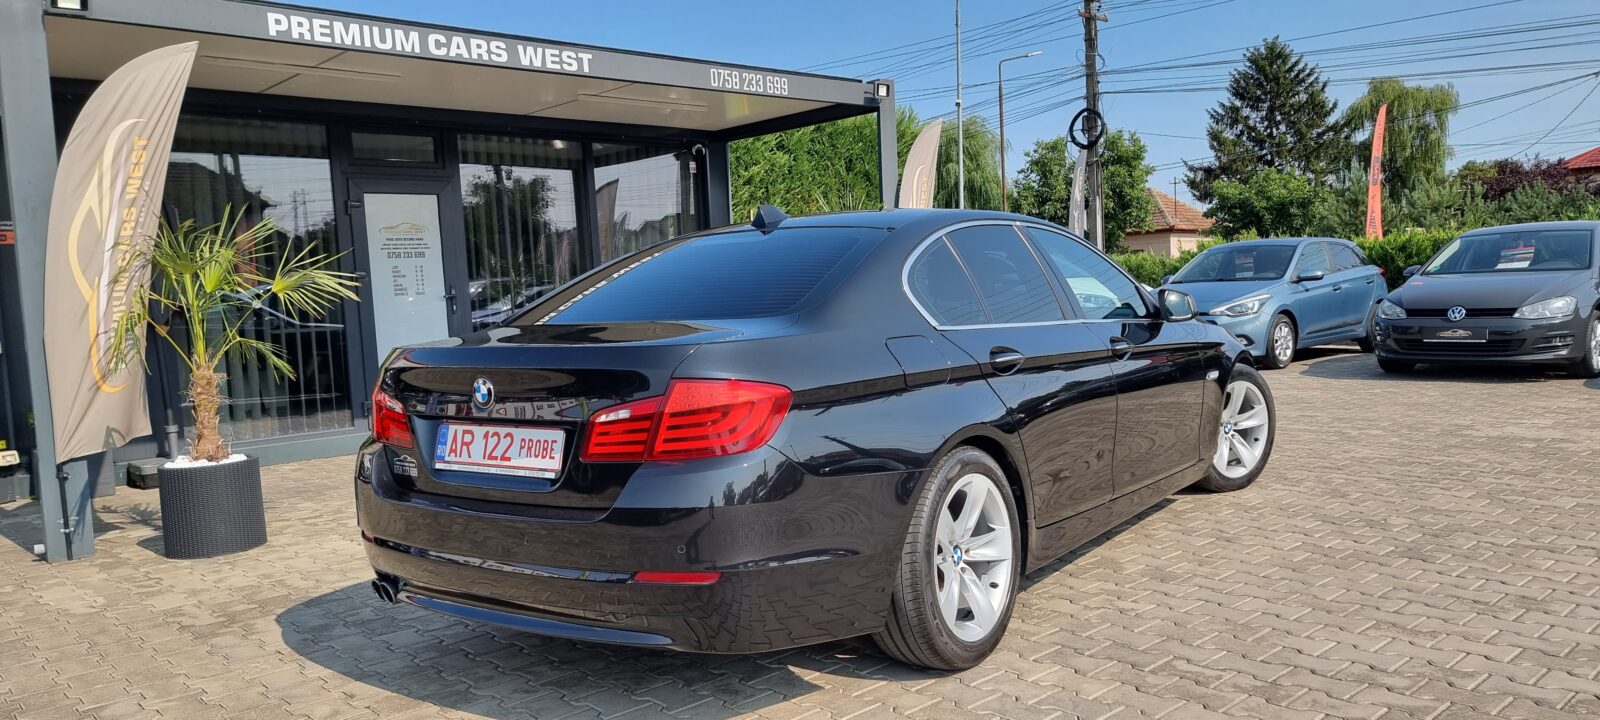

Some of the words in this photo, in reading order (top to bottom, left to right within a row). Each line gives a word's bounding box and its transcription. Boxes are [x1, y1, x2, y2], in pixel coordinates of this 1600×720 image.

[266, 12, 421, 54] PREMIUM
[428, 33, 508, 63] CARS
[517, 44, 593, 73] WEST
[710, 68, 740, 89] 0758
[742, 73, 764, 92] 233
[766, 76, 788, 95] 699
[126, 136, 148, 200] WEST
[387, 251, 401, 259] 0758
[402, 251, 413, 259] 233
[414, 251, 425, 259] 699
[437, 445, 446, 456] RO
[448, 429, 475, 458] AR
[482, 430, 514, 462] 122
[518, 437, 558, 460] PROBE
